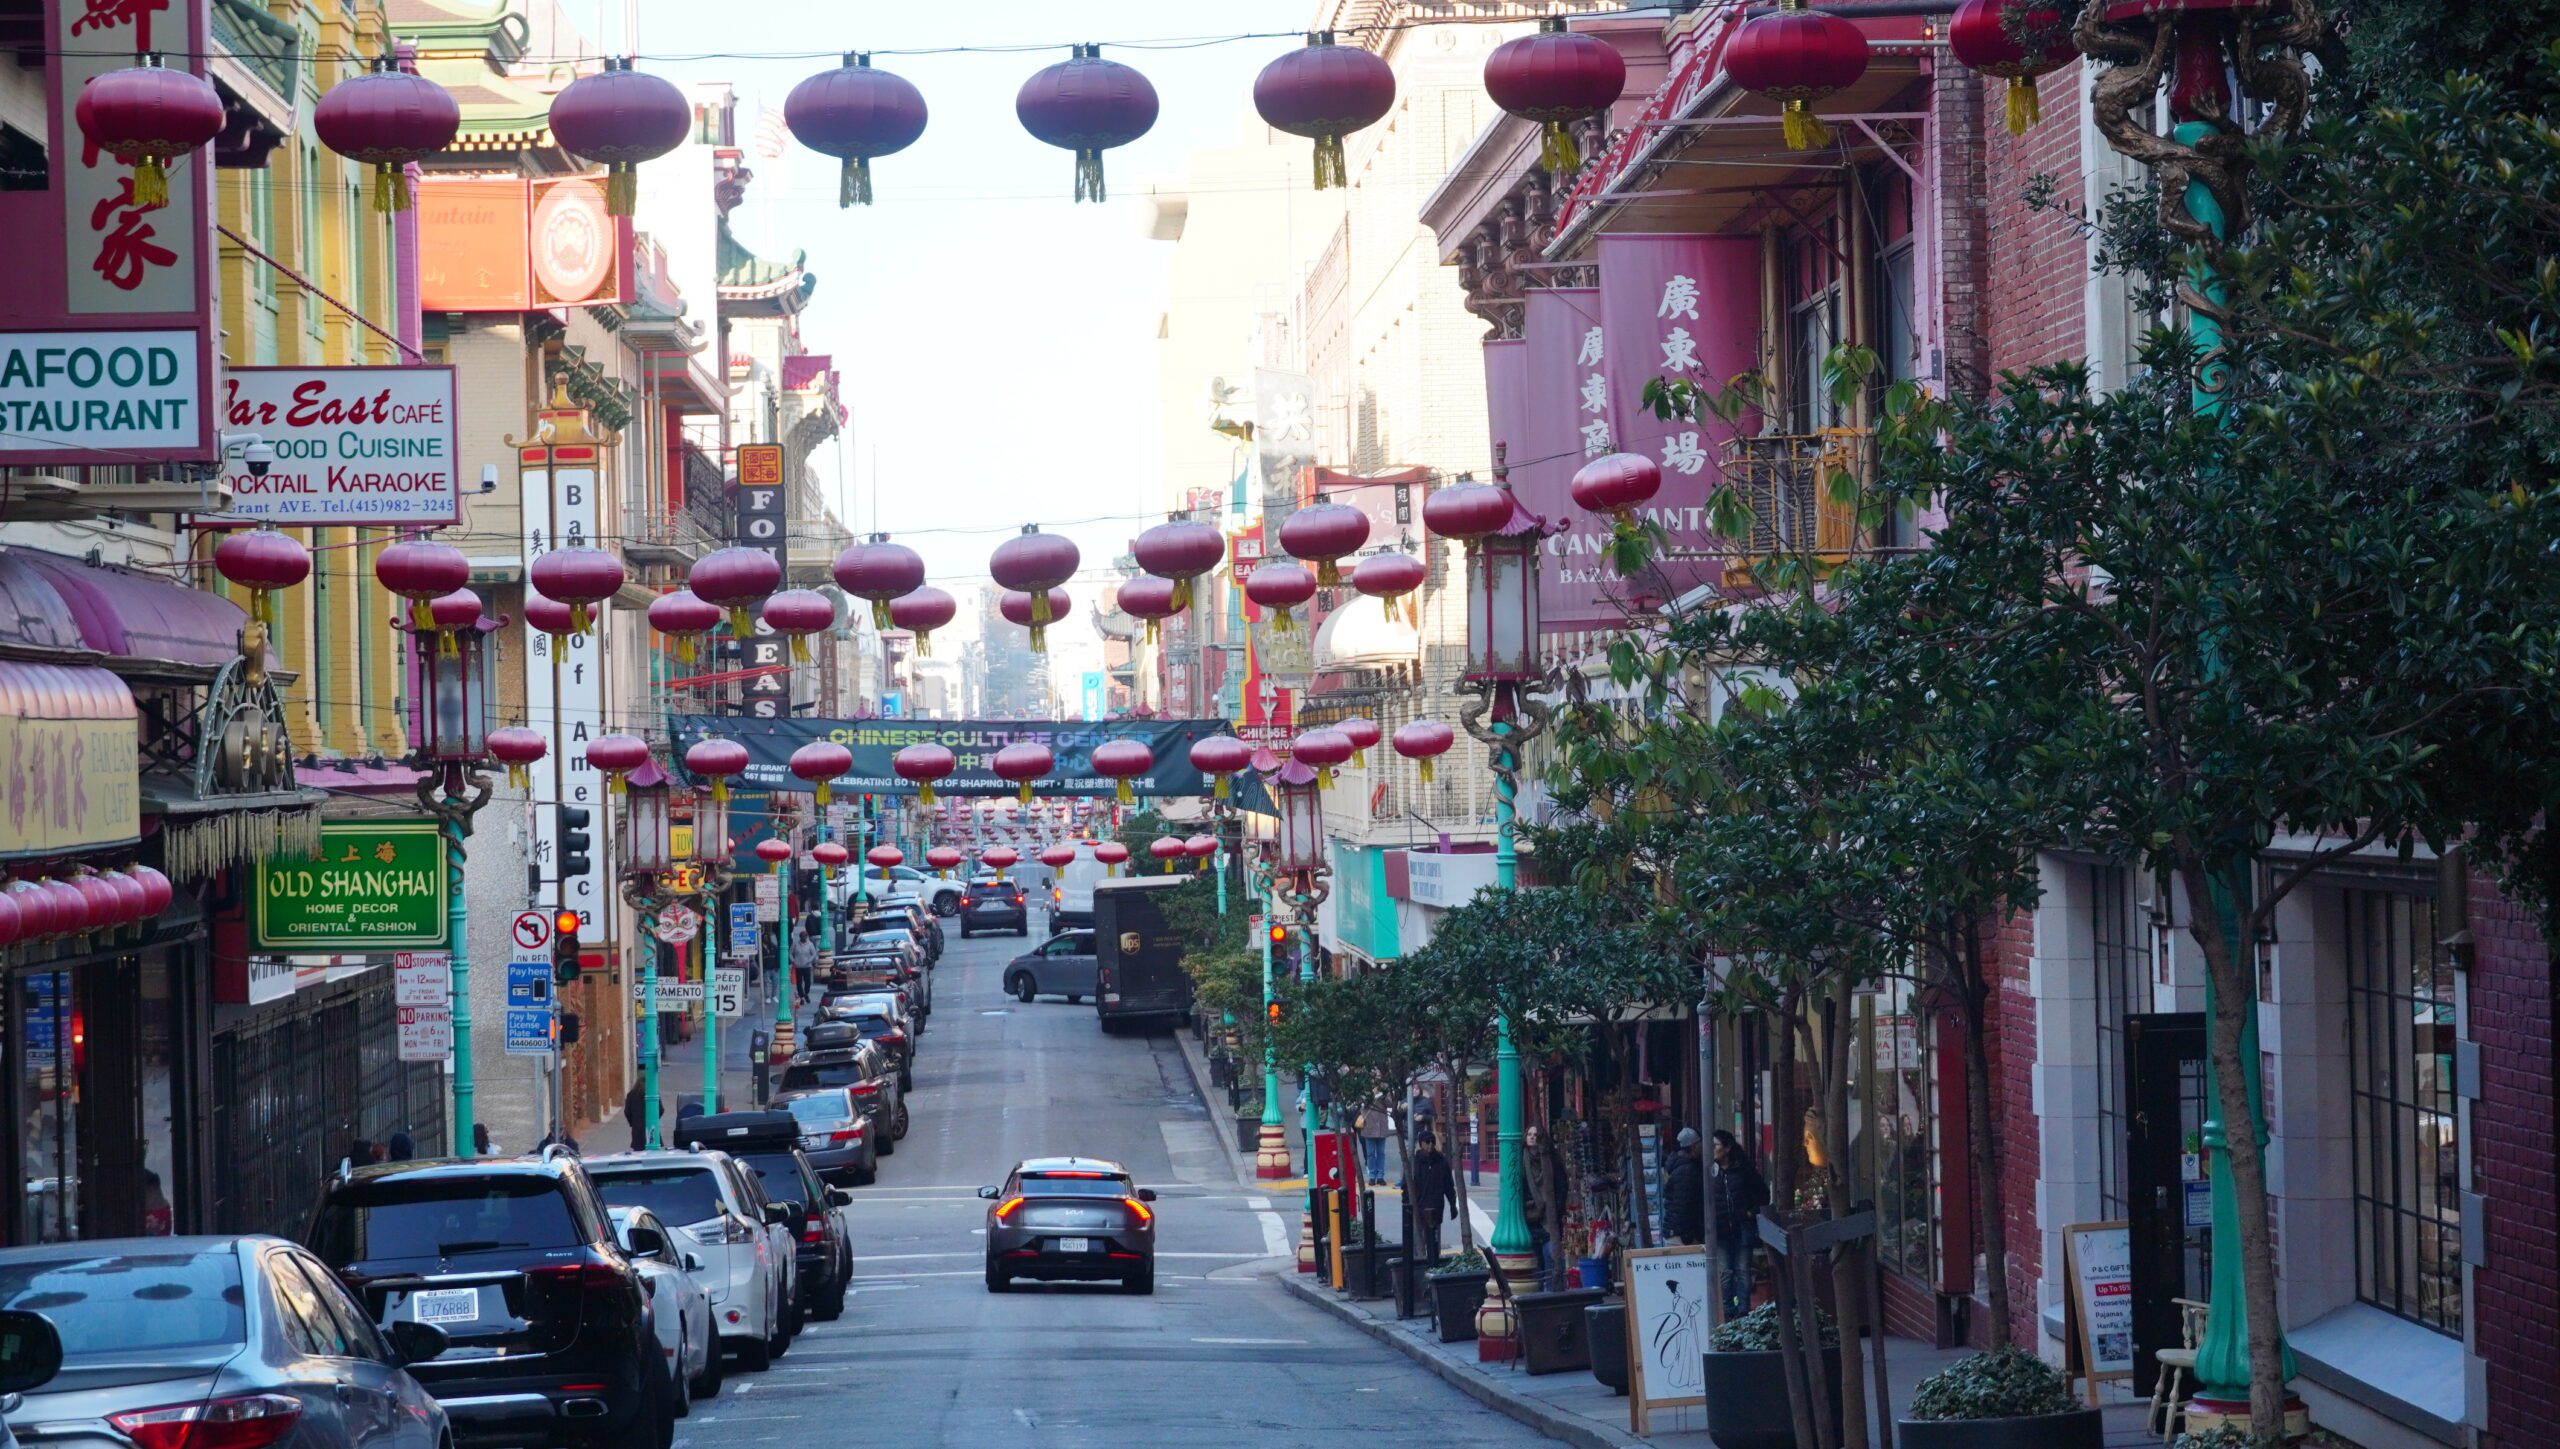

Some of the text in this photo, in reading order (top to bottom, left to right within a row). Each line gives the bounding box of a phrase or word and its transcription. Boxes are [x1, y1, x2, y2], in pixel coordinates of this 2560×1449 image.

[286, 380, 391, 427] East
[392, 399, 444, 424] CAFÉ
[338, 431, 443, 459] CUISINE
[328, 465, 447, 494] KARAOKE
[279, 501, 317, 513] AVE.
[945, 779, 959, 787] OF
[960, 779, 1004, 788] SHAPING
[270, 870, 435, 897] OLD SHANGHAI
[306, 903, 398, 914] HOME DECOR
[348, 913, 357, 922] &
[288, 922, 417, 932] ORIENTAL FASHION
[397, 954, 446, 968] NO STOPPING
[510, 966, 549, 977] Pay here
[715, 974, 741, 983] PEED
[634, 985, 702, 998] SARAMENTO
[400, 1008, 448, 1023] NO PARKING
[509, 1012, 538, 1022] Pay by
[509, 1021, 540, 1029] License
[509, 1029, 531, 1037] Plate
[404, 1039, 417, 1048] MON
[433, 1039, 444, 1048] FRI
[1644, 1263, 1651, 1271] &
[1664, 1262, 1682, 1270] Gift
[2098, 1285, 2109, 1294] Up
[2109, 1284, 2118, 1292] To
[2095, 1311, 2123, 1319] Pajamas
